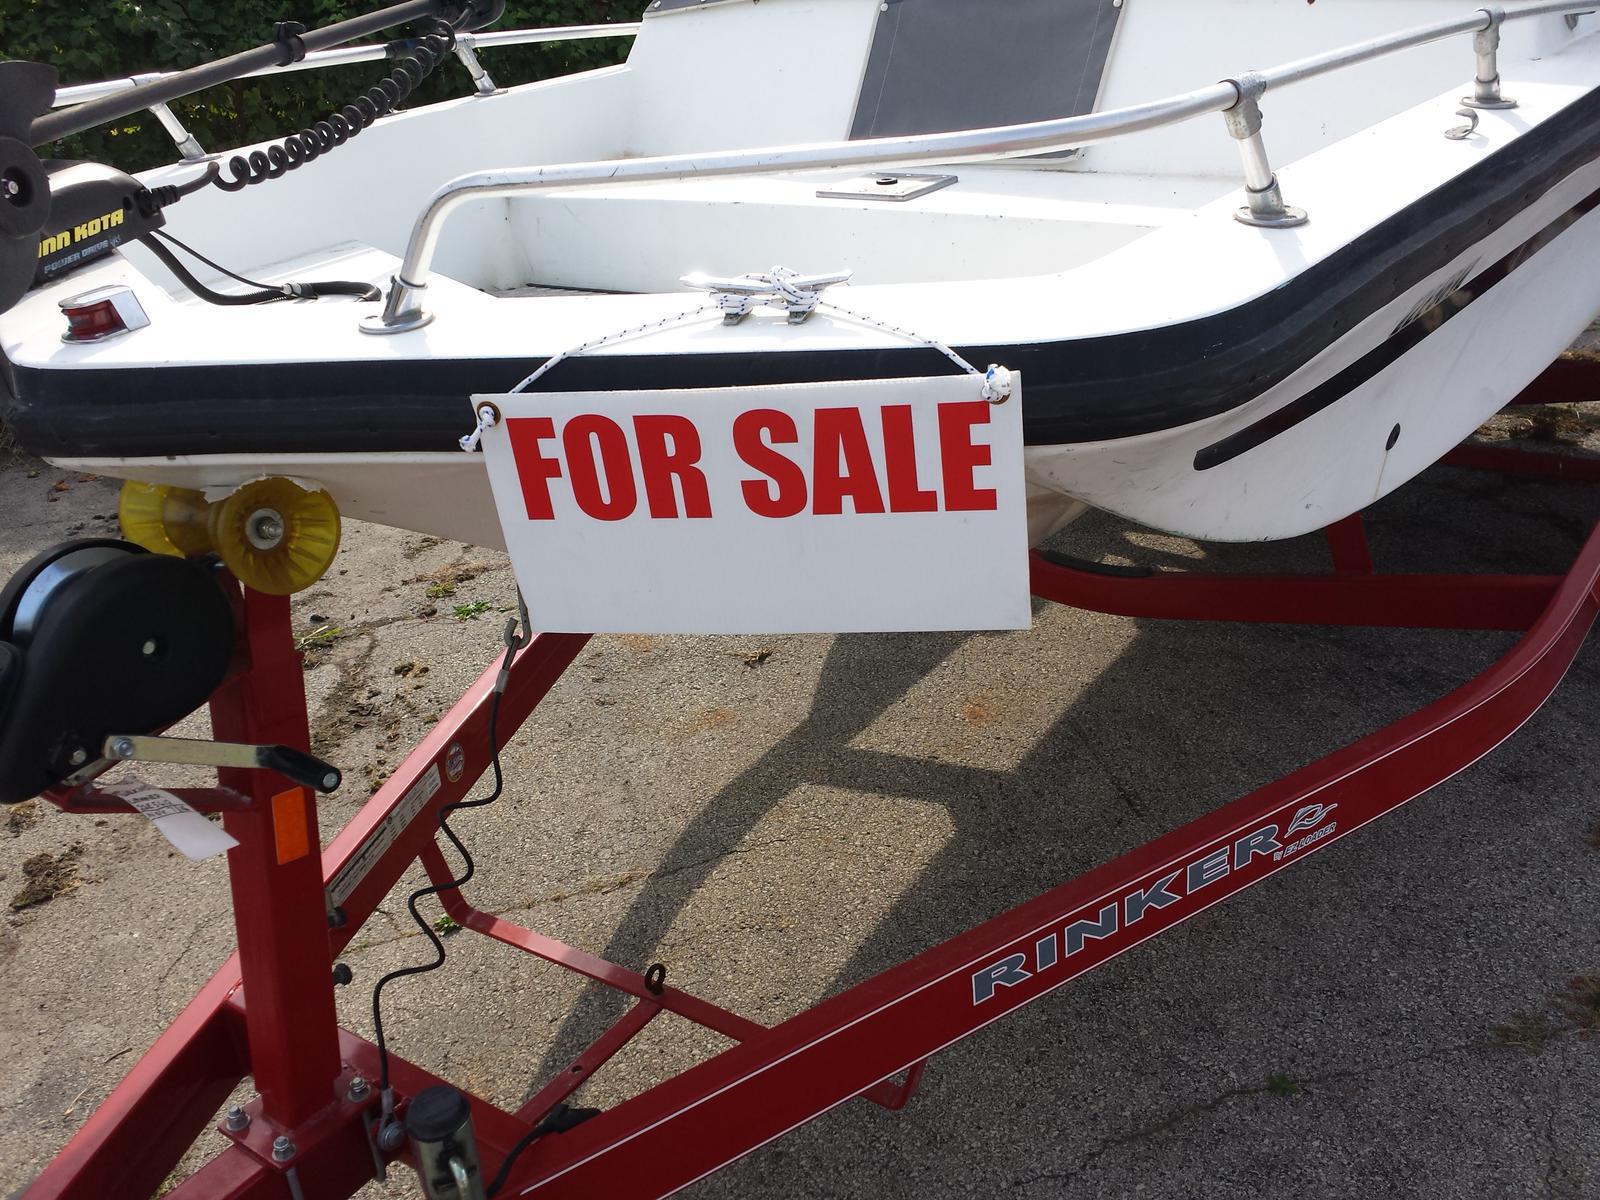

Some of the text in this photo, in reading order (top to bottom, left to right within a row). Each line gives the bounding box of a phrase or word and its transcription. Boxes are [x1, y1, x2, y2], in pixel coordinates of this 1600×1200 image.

[74, 208, 124, 243] KOTA
[44, 252, 81, 274] POWER
[505, 400, 997, 521] FOR SALE
[1283, 841, 1299, 857] EZ
[1298, 822, 1337, 850] LOADER
[972, 824, 1282, 1005] RINKER
